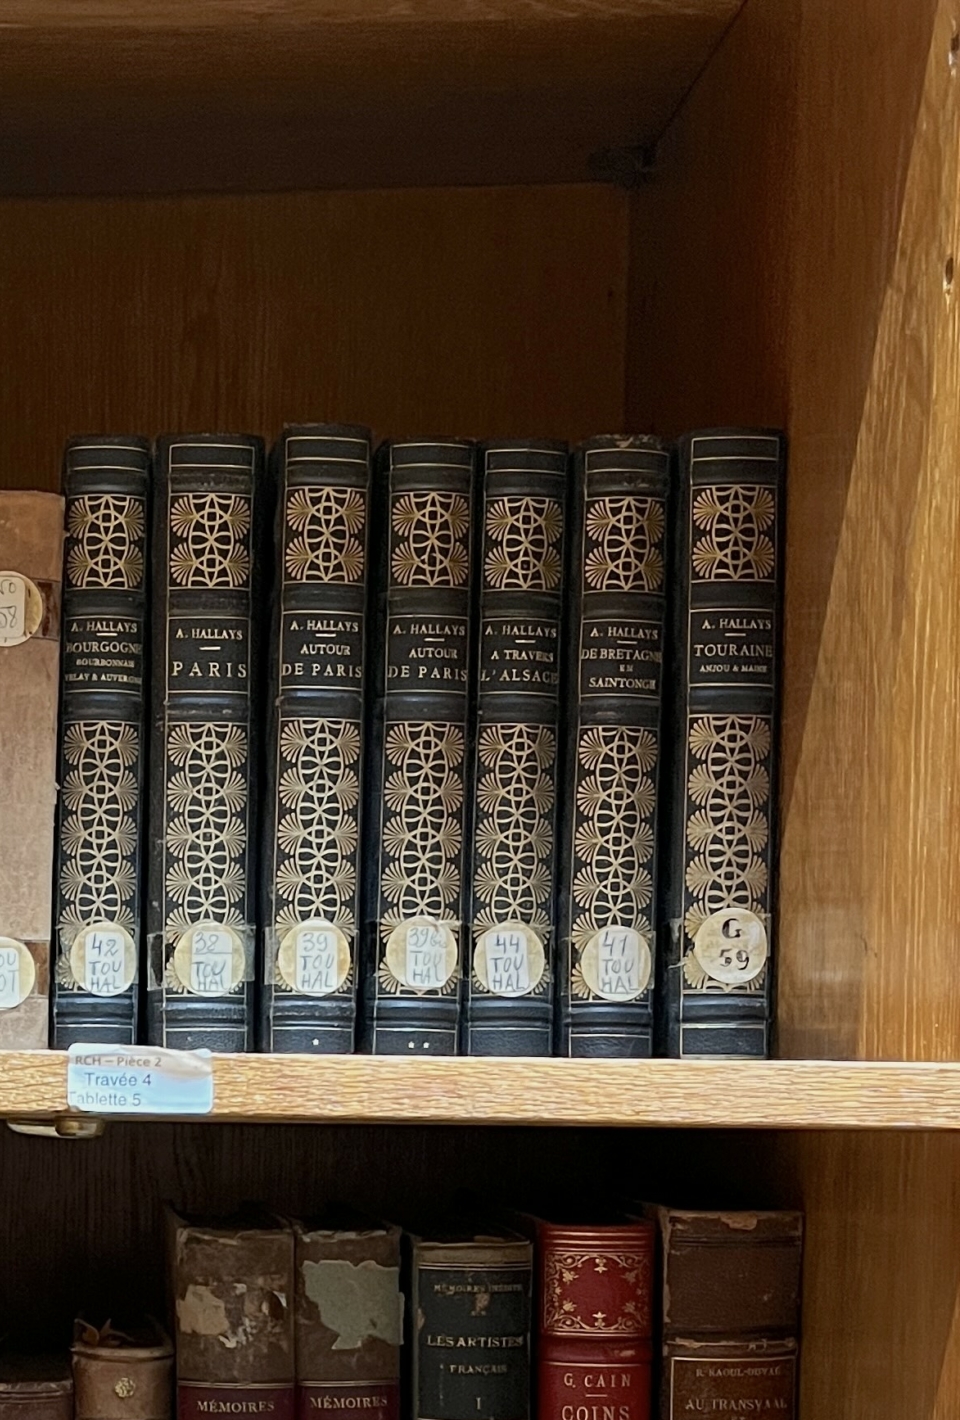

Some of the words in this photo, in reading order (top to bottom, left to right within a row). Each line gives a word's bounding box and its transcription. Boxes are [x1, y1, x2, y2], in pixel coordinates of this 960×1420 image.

[71, 622, 83, 632] A.
[86, 621, 137, 633] HALLAYS
[290, 620, 304, 631] A.
[306, 619, 359, 633] HALLAYS
[393, 624, 406, 636] A.
[410, 623, 465, 637] HALLAYS
[485, 625, 498, 637] A.
[502, 624, 557, 639] HALLAYS
[702, 619, 715, 630] A.
[719, 618, 772, 630] HALLAYS
[176, 630, 188, 640] A.
[191, 628, 243, 641] HALLAYS
[590, 627, 604, 637] A.
[608, 626, 658, 640] HALLAYS
[66, 641, 142, 654] BOURGOGNE
[300, 644, 351, 657] AUTOUR
[409, 647, 458, 660] AUTOUR
[694, 644, 773, 658] TOURAINE
[581, 648, 597, 660] DE
[600, 648, 662, 663] BRETAGNE
[172, 661, 247, 679] PARIS
[281, 662, 304, 678] DE
[311, 663, 363, 679] PARIS
[388, 666, 410, 678] DE
[418, 665, 468, 682] PARIS
[480, 667, 559, 685] L'ALSACE
[589, 677, 656, 690] SAINTONGE
[496, 934, 520, 954] 44
[90, 960, 122, 977] TOU
[301, 953, 335, 969] TOU
[490, 955, 524, 973] TOU
[601, 956, 635, 974] TOU
[90, 974, 122, 993] HAL
[301, 969, 335, 988] HAL
[492, 972, 526, 991] HAL
[600, 973, 639, 993] HAL
[75, 1054, 102, 1067] RCH
[117, 1054, 152, 1068] Pièce
[154, 1056, 162, 1068] 2
[84, 1071, 137, 1088] Travée
[142, 1073, 152, 1087] 4
[68, 1090, 127, 1107] Tablette
[131, 1093, 142, 1107] 5
[427, 1335, 454, 1347] LES
[456, 1336, 523, 1348] ARTISTES
[564, 1373, 576, 1388] G.
[584, 1373, 631, 1388] CAIN
[197, 1399, 275, 1414] MÉMOIRES
[309, 1395, 388, 1410] MÉMOIRES
[685, 1398, 704, 1410] AU
[712, 1398, 788, 1411] TRANSVAAL
